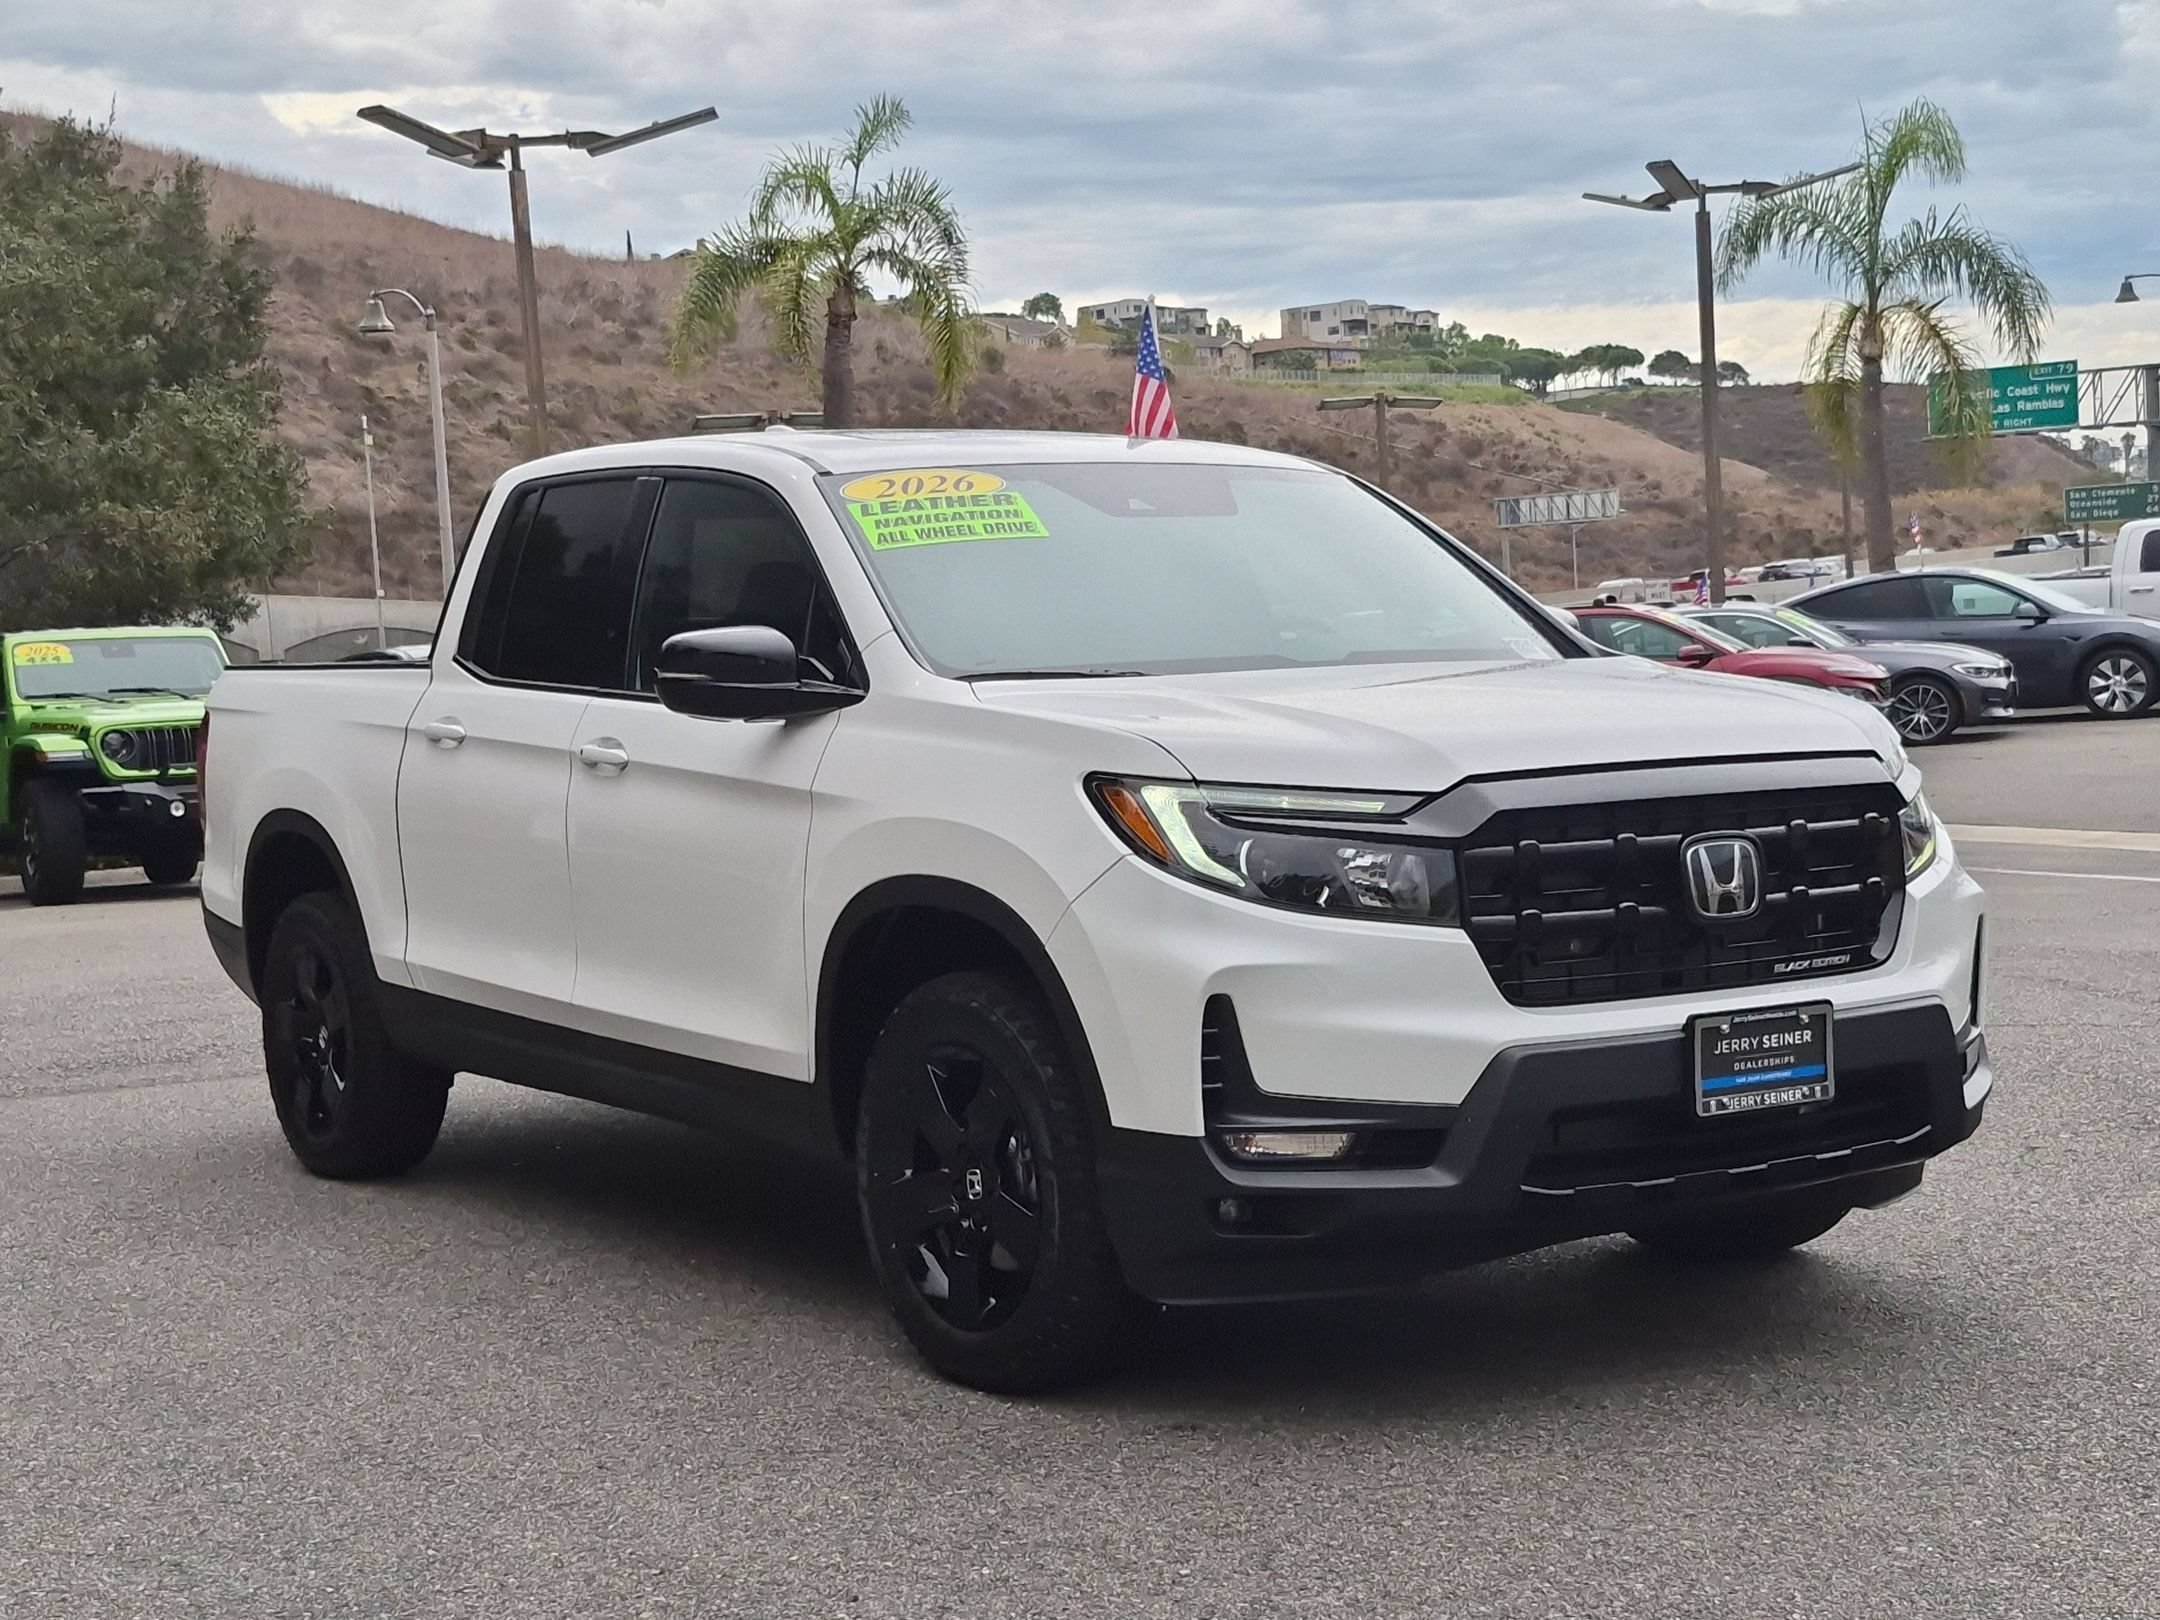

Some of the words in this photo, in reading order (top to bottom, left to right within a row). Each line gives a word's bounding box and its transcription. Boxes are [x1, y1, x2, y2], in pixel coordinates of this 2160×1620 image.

[2034, 367, 2053, 376] EXIT
[2058, 363, 2074, 374] 79
[2007, 386, 2039, 397] Coast
[2045, 383, 2071, 395] Hwy
[2017, 399, 2065, 412] Ramblas
[2004, 418, 2034, 428] RIGHT
[876, 474, 974, 499] 2026
[2069, 491, 2087, 499] San
[2092, 488, 2136, 497] Clemente
[860, 493, 1017, 518] LEATHER
[2069, 498, 2118, 508] Oceanside
[2146, 494, 2159, 503] 27
[874, 508, 1024, 530] NAVIGATION
[2070, 511, 2087, 519] San
[2093, 509, 2119, 519] Diego
[877, 530, 911, 545] ALL
[915, 524, 977, 542] WHEEL
[983, 520, 1036, 535] DRIVE
[1774, 959, 1811, 973] BLACK
[1714, 1036, 1760, 1054] JERRY
[1762, 1030, 1812, 1049] SEINER
[1733, 1055, 1795, 1071] DEALERSHIPS
[1728, 1094, 1762, 1109] JERRY
[1764, 1089, 1803, 1105] SEINER
